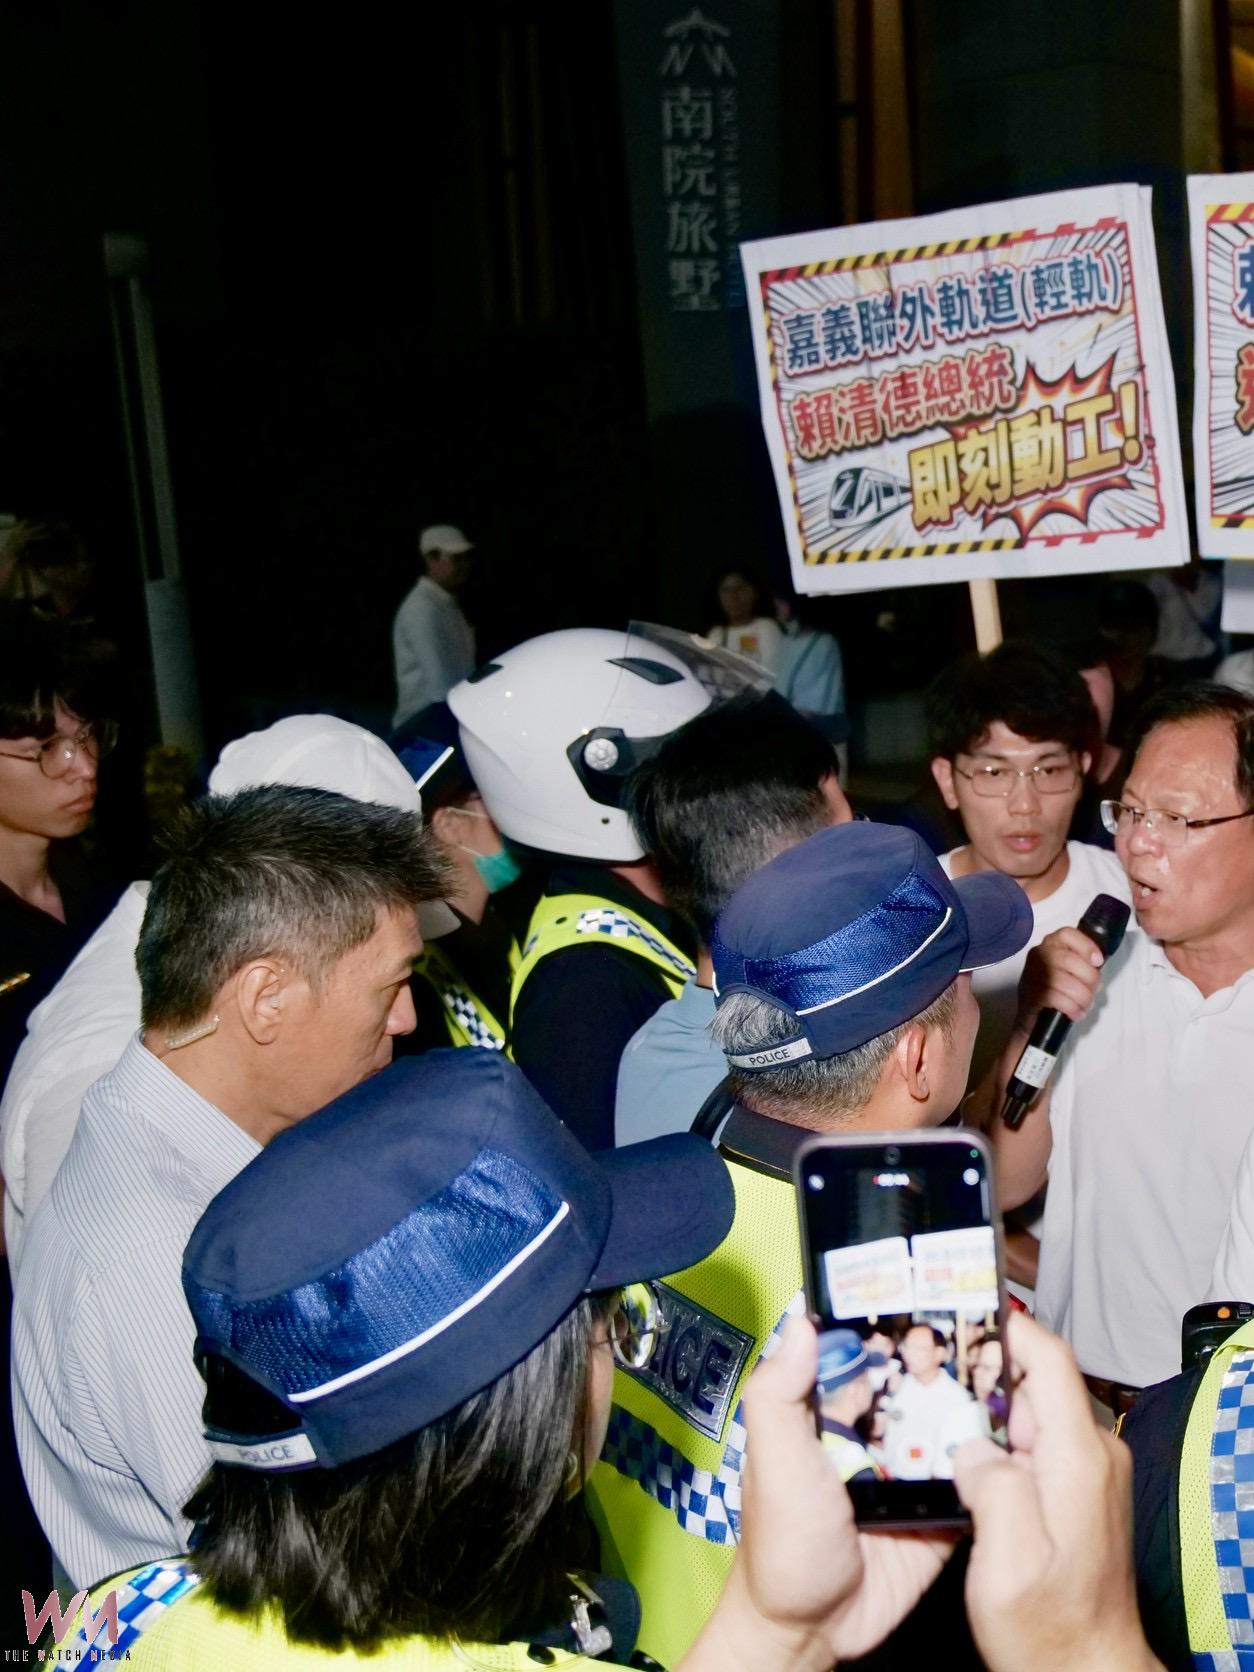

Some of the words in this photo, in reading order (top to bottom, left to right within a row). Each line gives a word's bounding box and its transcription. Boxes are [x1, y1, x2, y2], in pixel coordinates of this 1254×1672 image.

[661, 86, 721, 311] 南院旅墅
[782, 252, 1124, 371] 嘉義聯外軌道(輕軌)
[793, 347, 1016, 456] 賴清德總統
[909, 382, 1146, 528] 即刻動工!
[748, 1048, 791, 1066] POLICE
